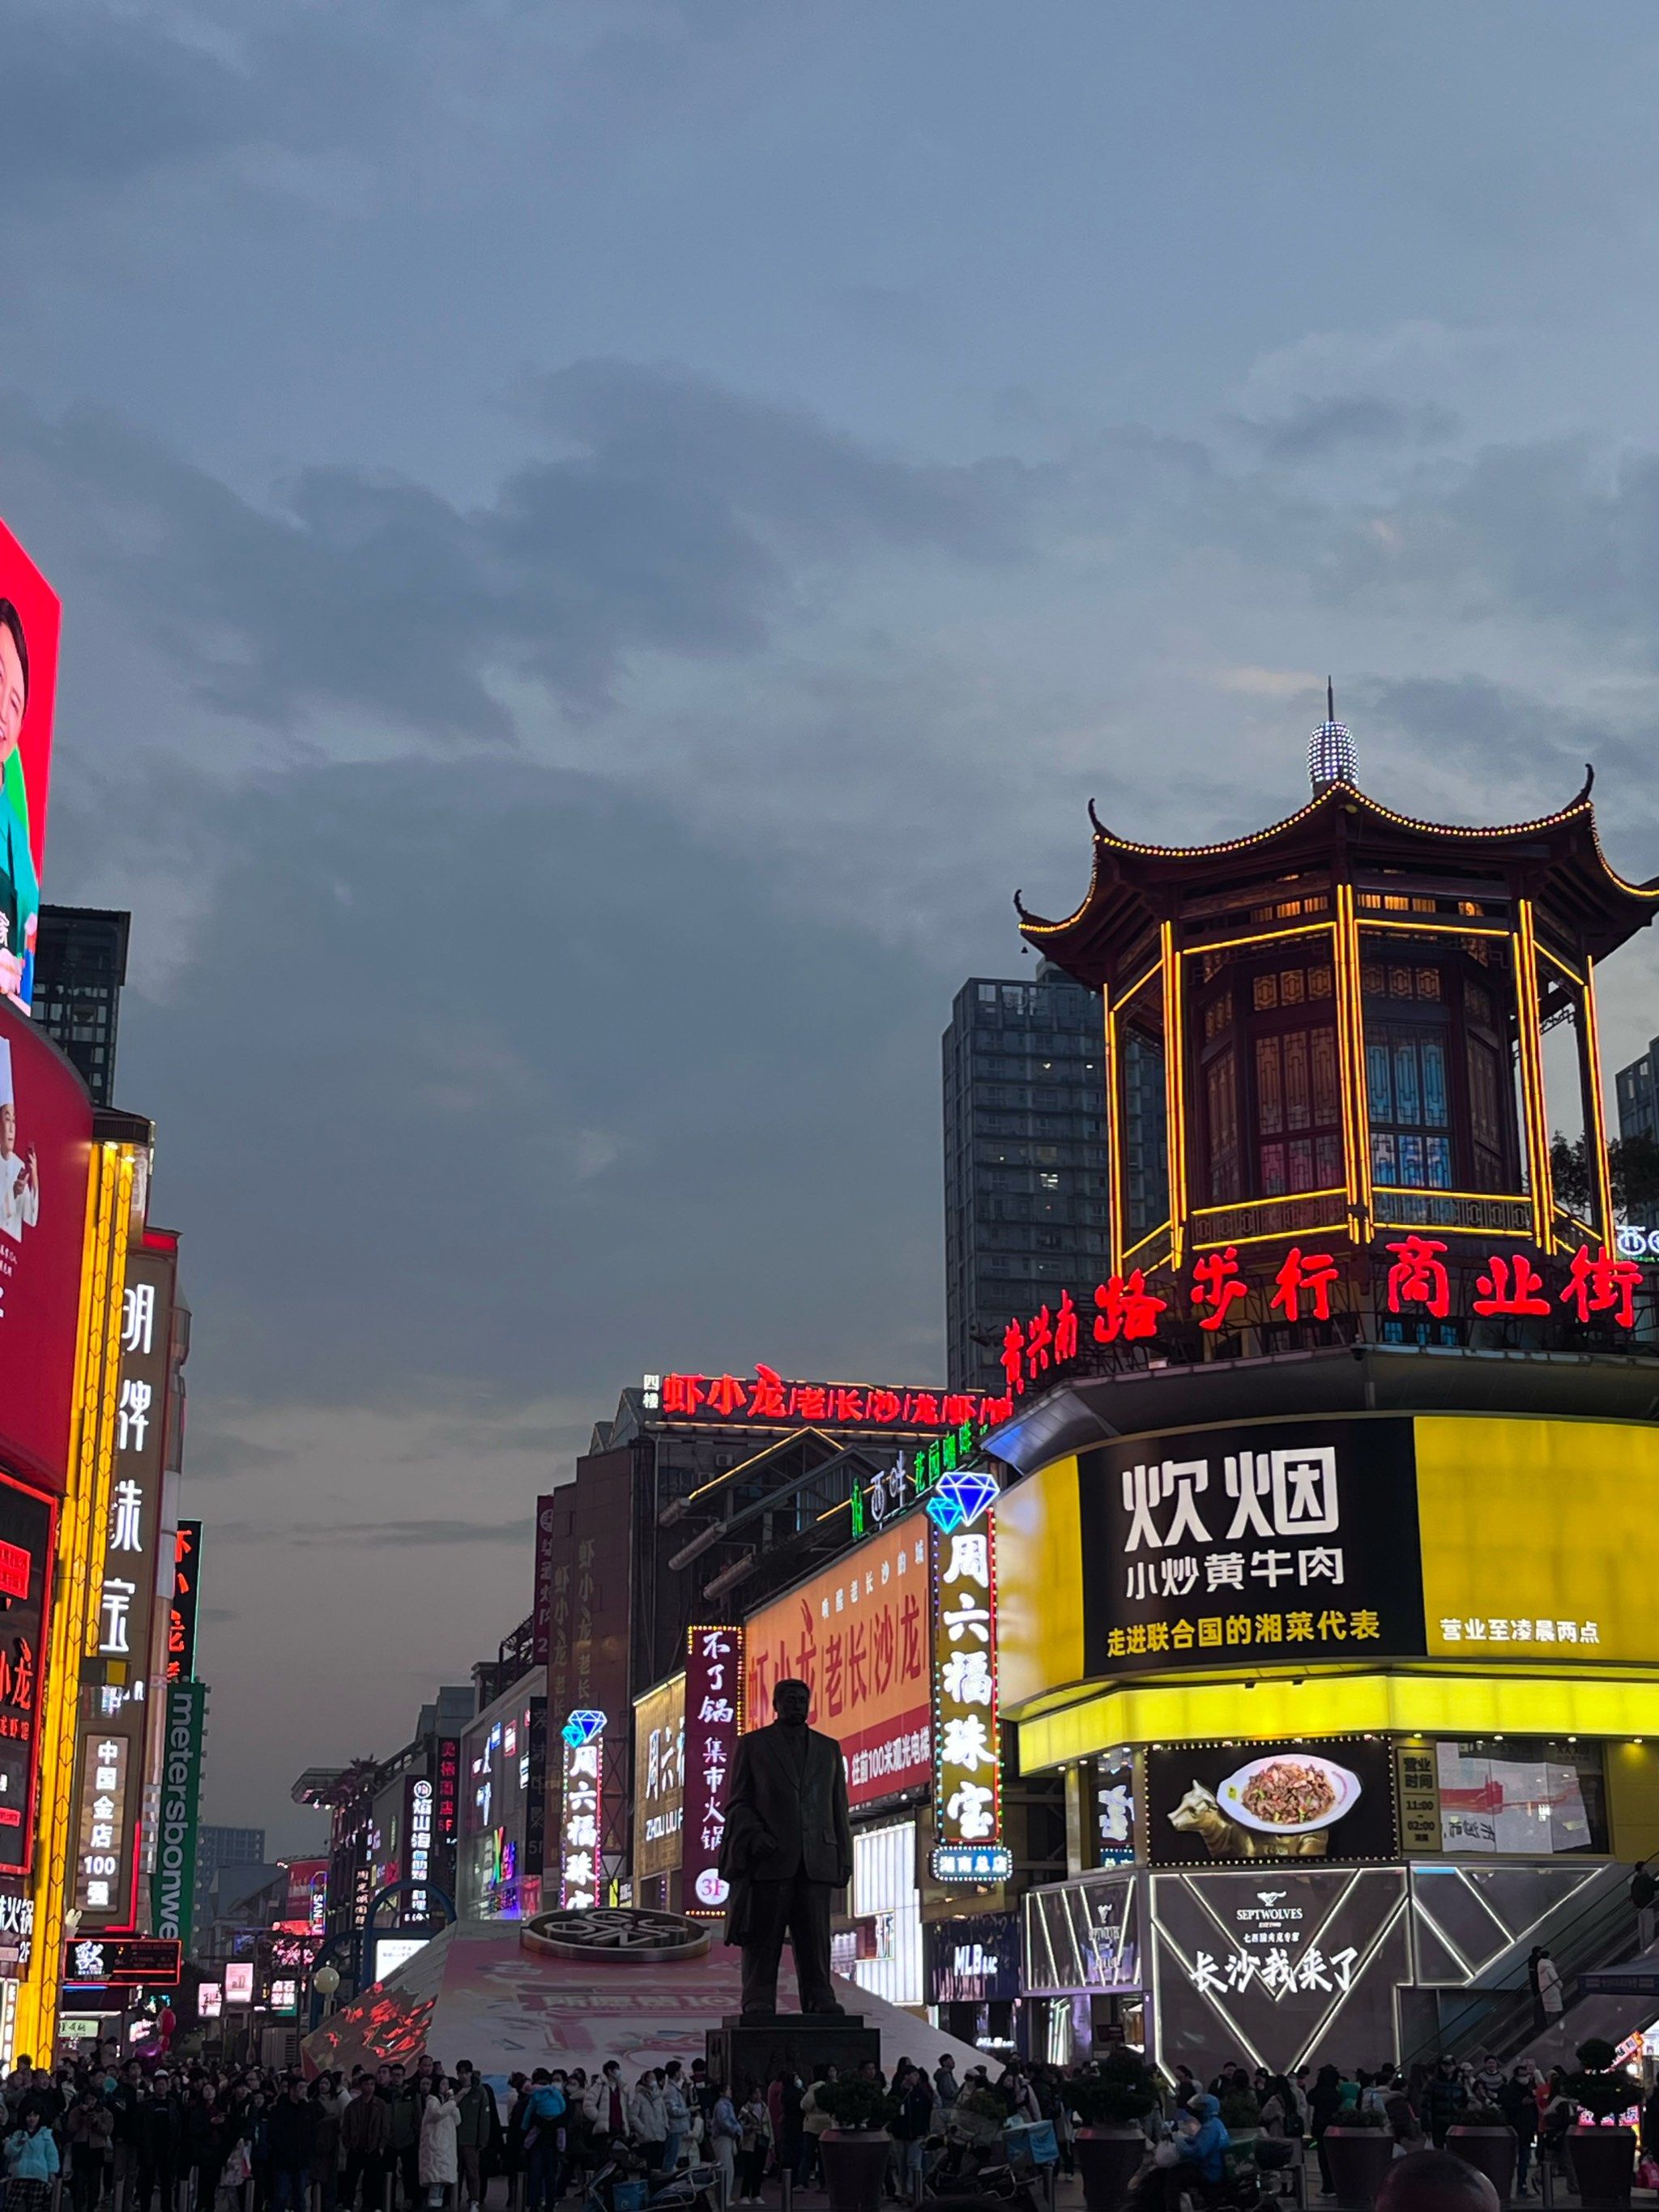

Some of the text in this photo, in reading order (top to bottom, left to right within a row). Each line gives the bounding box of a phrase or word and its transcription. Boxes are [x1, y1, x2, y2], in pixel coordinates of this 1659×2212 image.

[1000, 1235, 1644, 1400] 黄兴南路步行商业街
[1122, 1446, 1339, 1552] 炊烟
[1126, 1547, 1345, 1599] 小炒黄牛肉
[1107, 1609, 1380, 1658] 走进联合国的湘菜代表
[1440, 1617, 1601, 1644] 营业至凌晨两点
[942, 1534, 998, 1839] 周六福珠宝
[159, 1693, 194, 1940] metersbonwe
[701, 1736, 728, 1851] 集市火锅
[1406, 1800, 1434, 1811] 11:00
[1236, 1908, 1303, 1920] SEPTWOLVES
[1190, 1947, 1358, 1993] 长沙我来了
